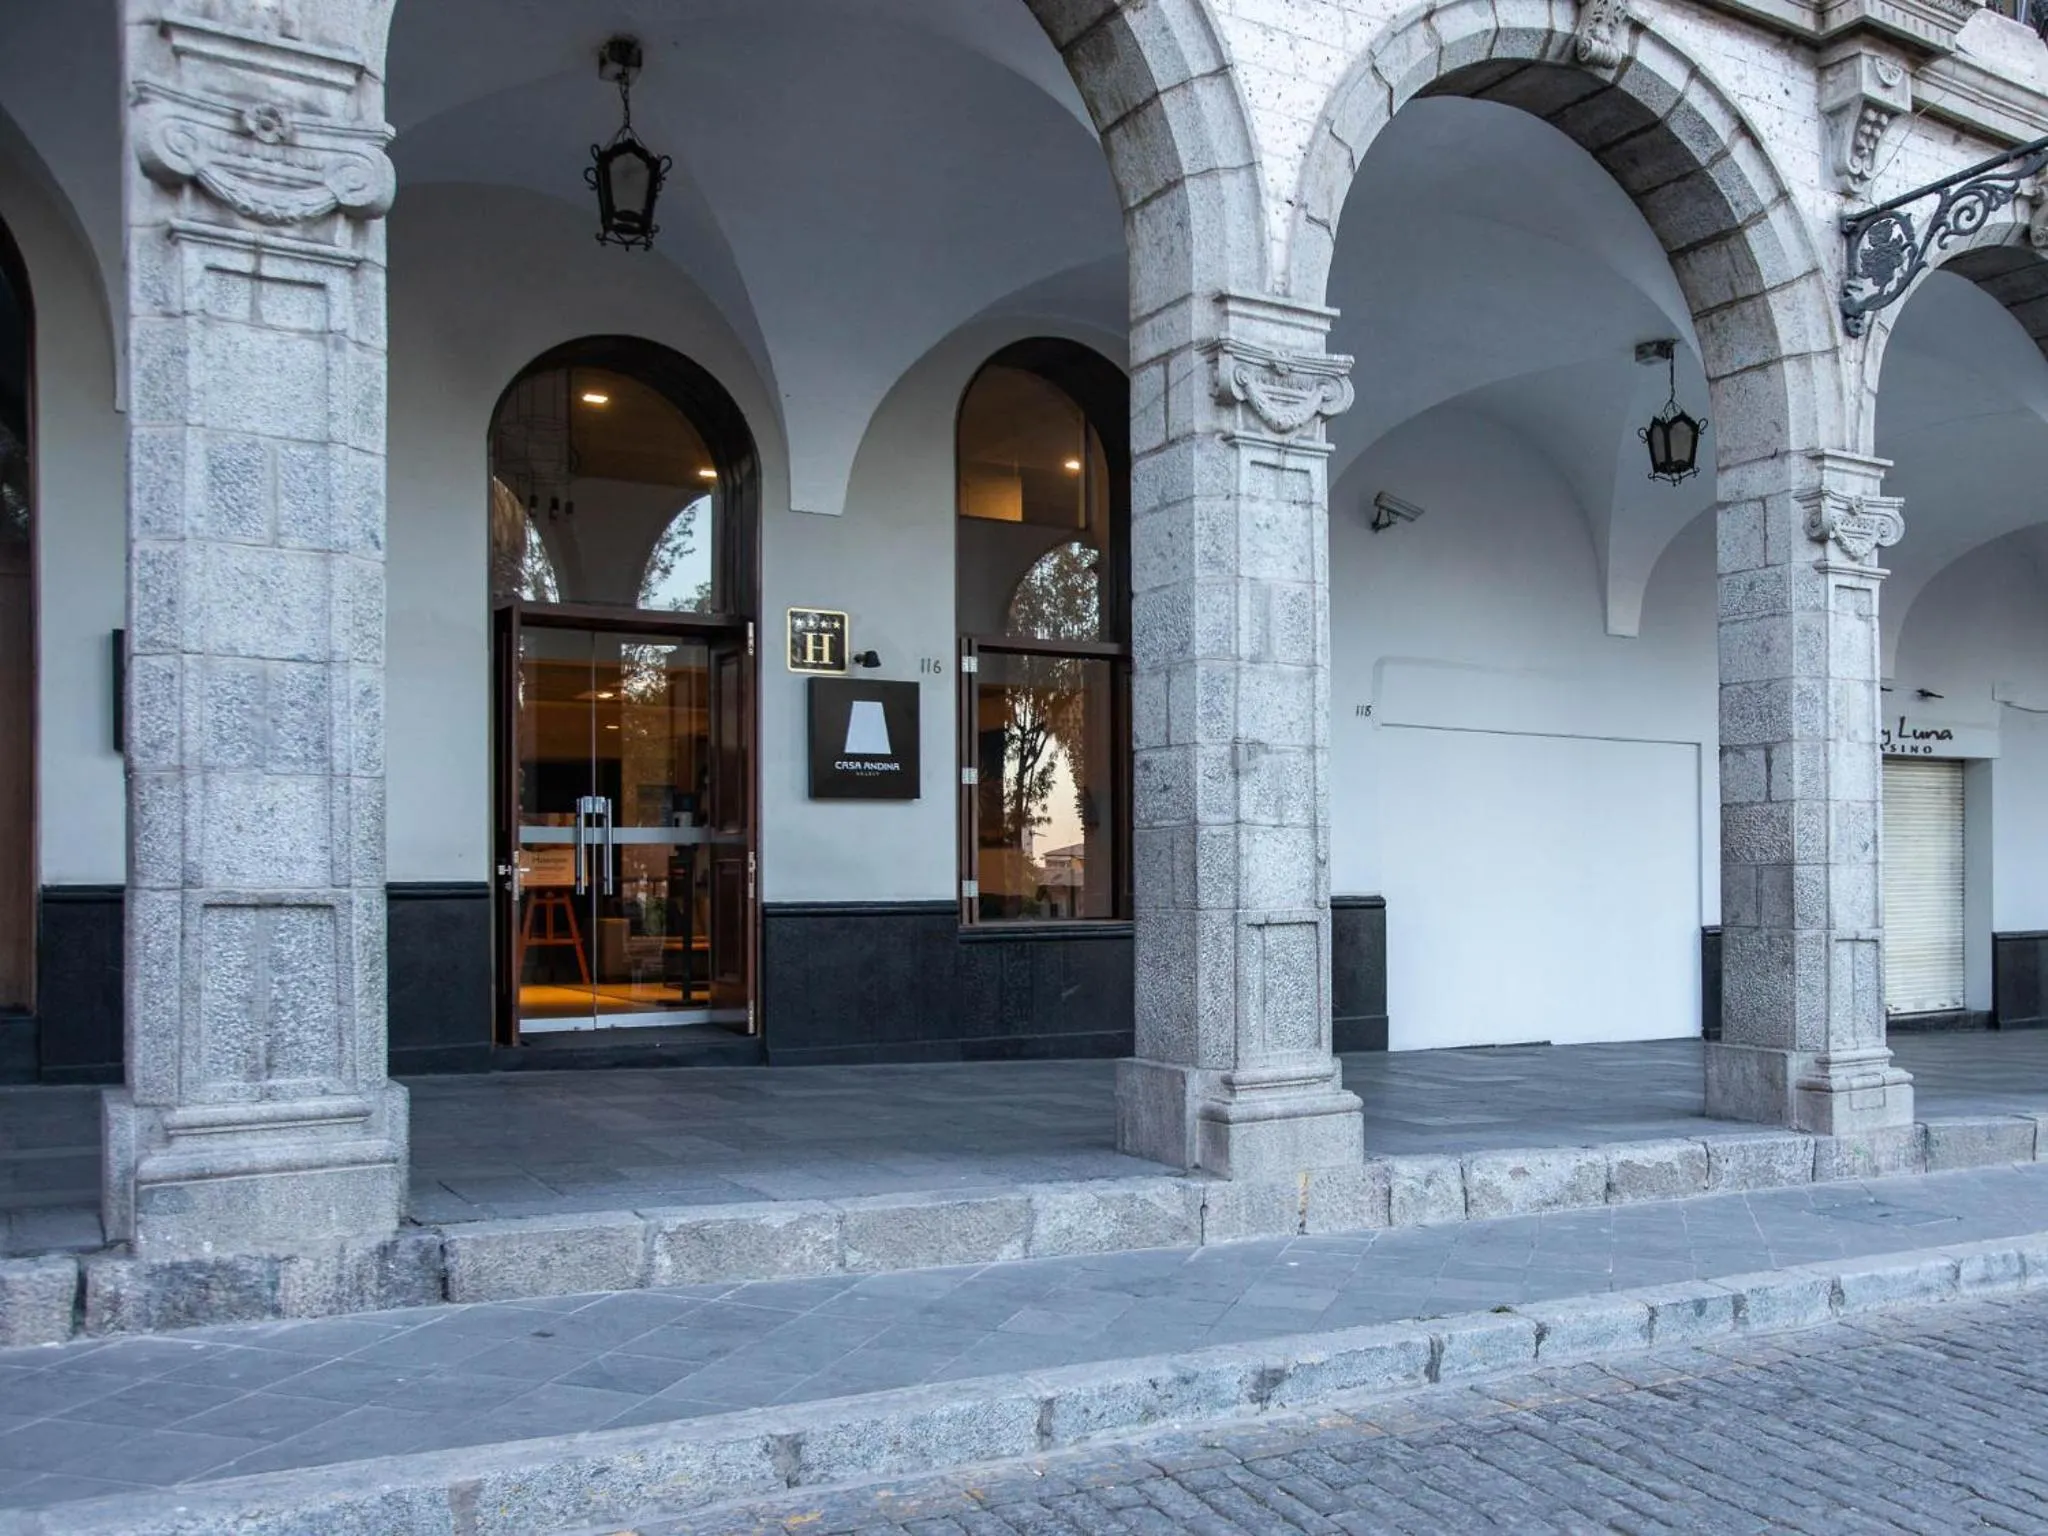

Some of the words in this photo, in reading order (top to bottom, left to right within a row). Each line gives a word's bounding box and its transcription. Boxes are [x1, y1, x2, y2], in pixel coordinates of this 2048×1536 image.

[802, 631, 834, 664] H
[920, 657, 942, 674] 116
[1898, 715, 1953, 740] Luna
[834, 761, 862, 770] CASA
[863, 761, 901, 771] ANDINA
